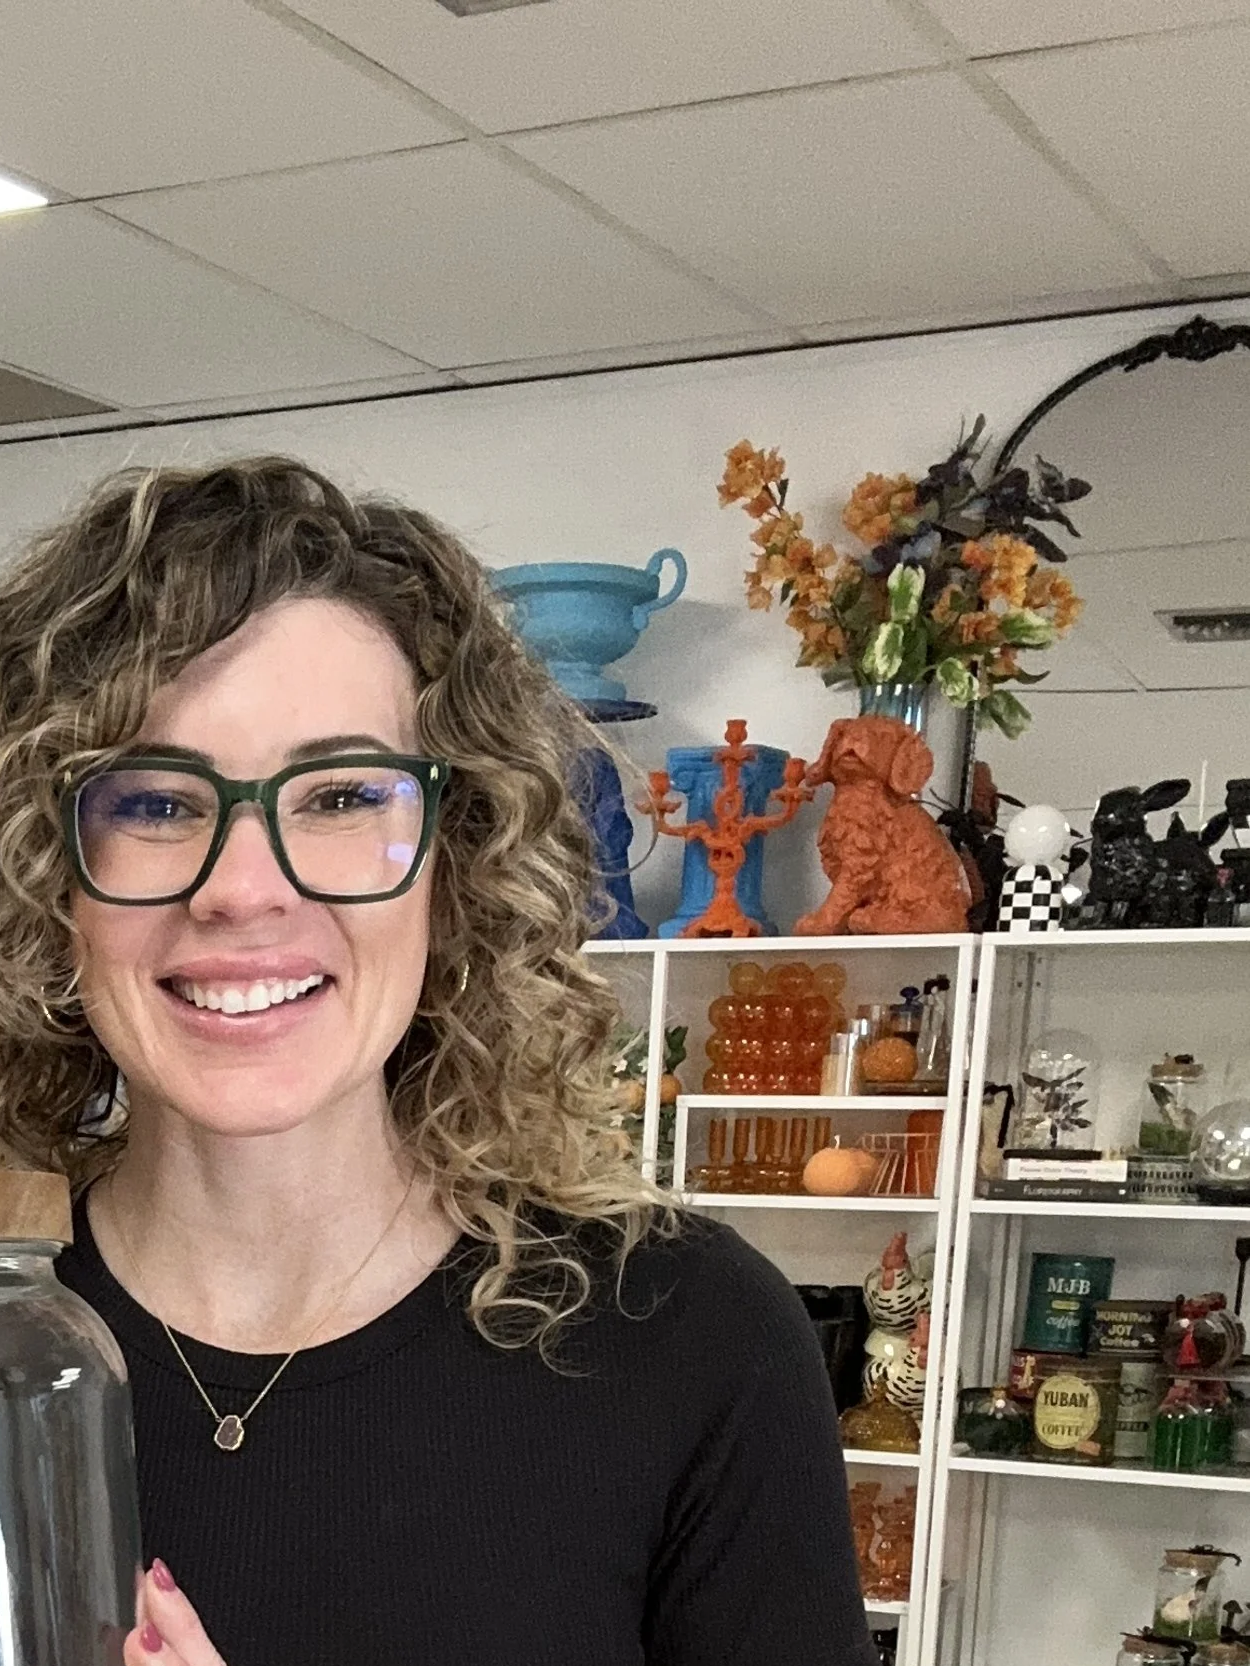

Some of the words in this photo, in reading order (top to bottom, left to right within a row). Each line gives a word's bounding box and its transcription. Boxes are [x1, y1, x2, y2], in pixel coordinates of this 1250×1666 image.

[1108, 1324, 1134, 1336] JOY
[1043, 1390, 1090, 1408] YUBAN
[1041, 1423, 1082, 1437] COFFEE
